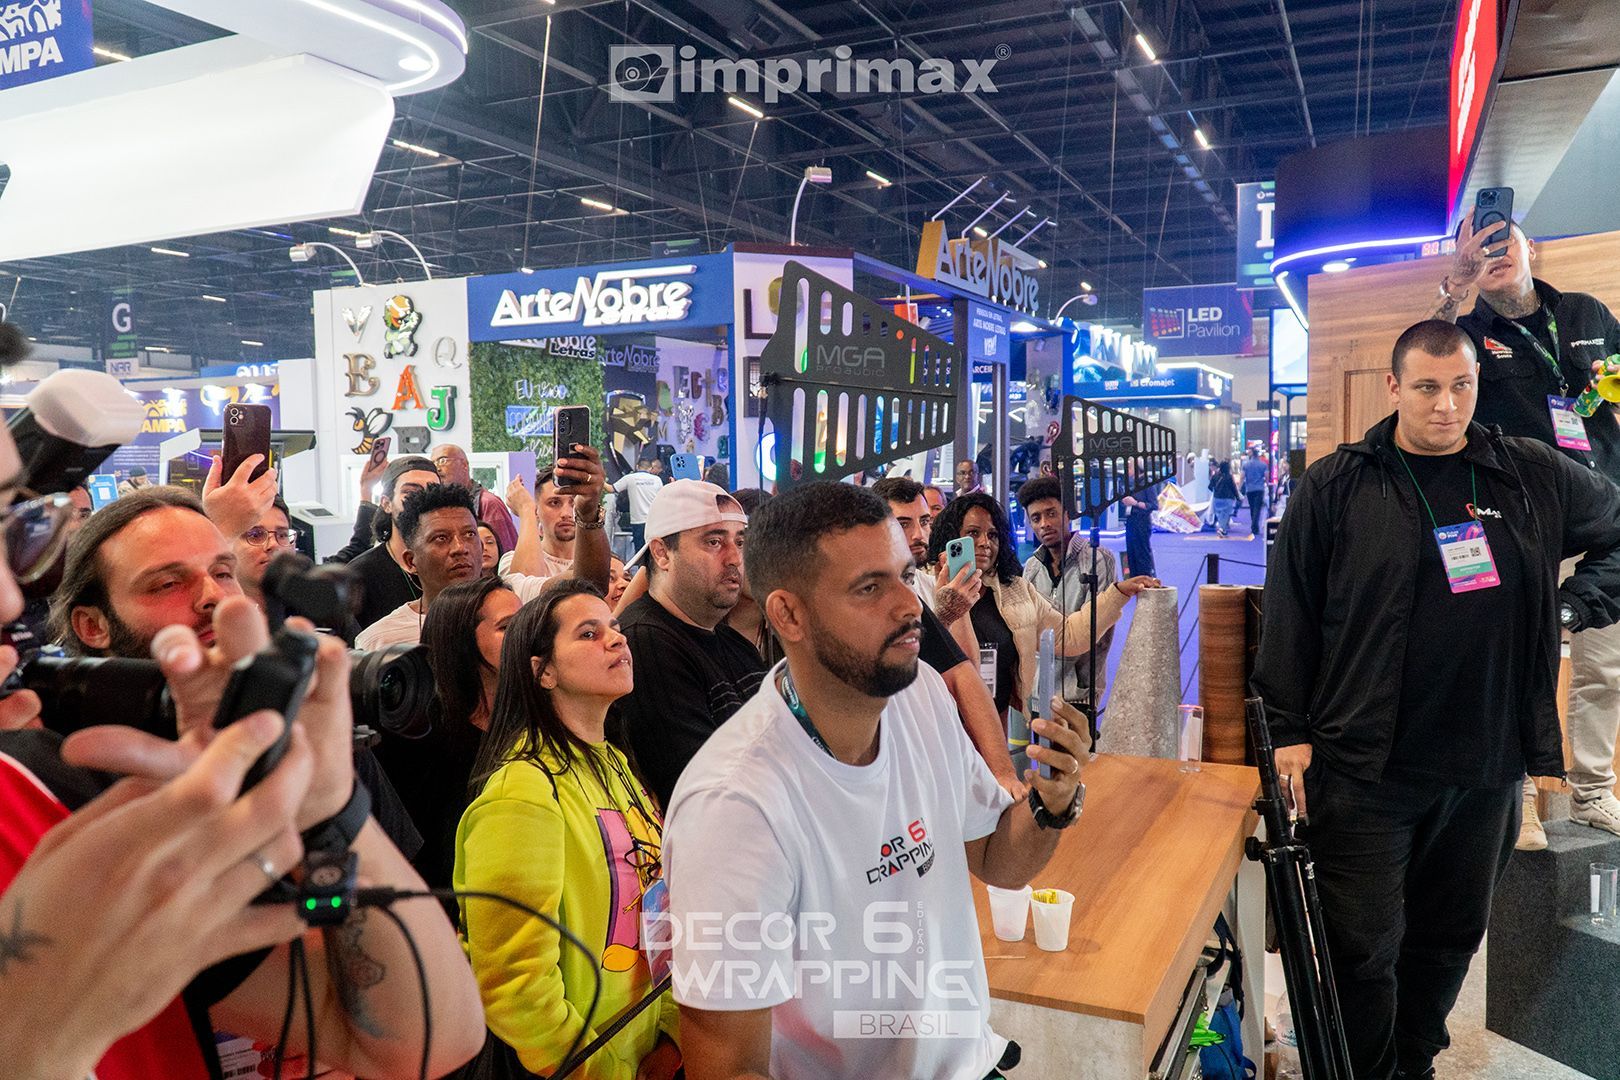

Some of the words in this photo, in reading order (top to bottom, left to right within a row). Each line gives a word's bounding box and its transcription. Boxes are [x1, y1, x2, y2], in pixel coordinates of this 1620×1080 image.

[935, 220, 1044, 312] ArteNobre
[491, 265, 695, 326] ArteNobre
[112, 303, 131, 332] G
[1187, 307, 1223, 322] LED
[1187, 323, 1241, 338] Pavilion
[551, 344, 595, 358] Letras
[817, 345, 885, 368] MGA
[392, 364, 427, 411] A
[427, 385, 457, 432] J
[1089, 436, 1134, 450] MGA
[908, 820, 926, 843] 6
